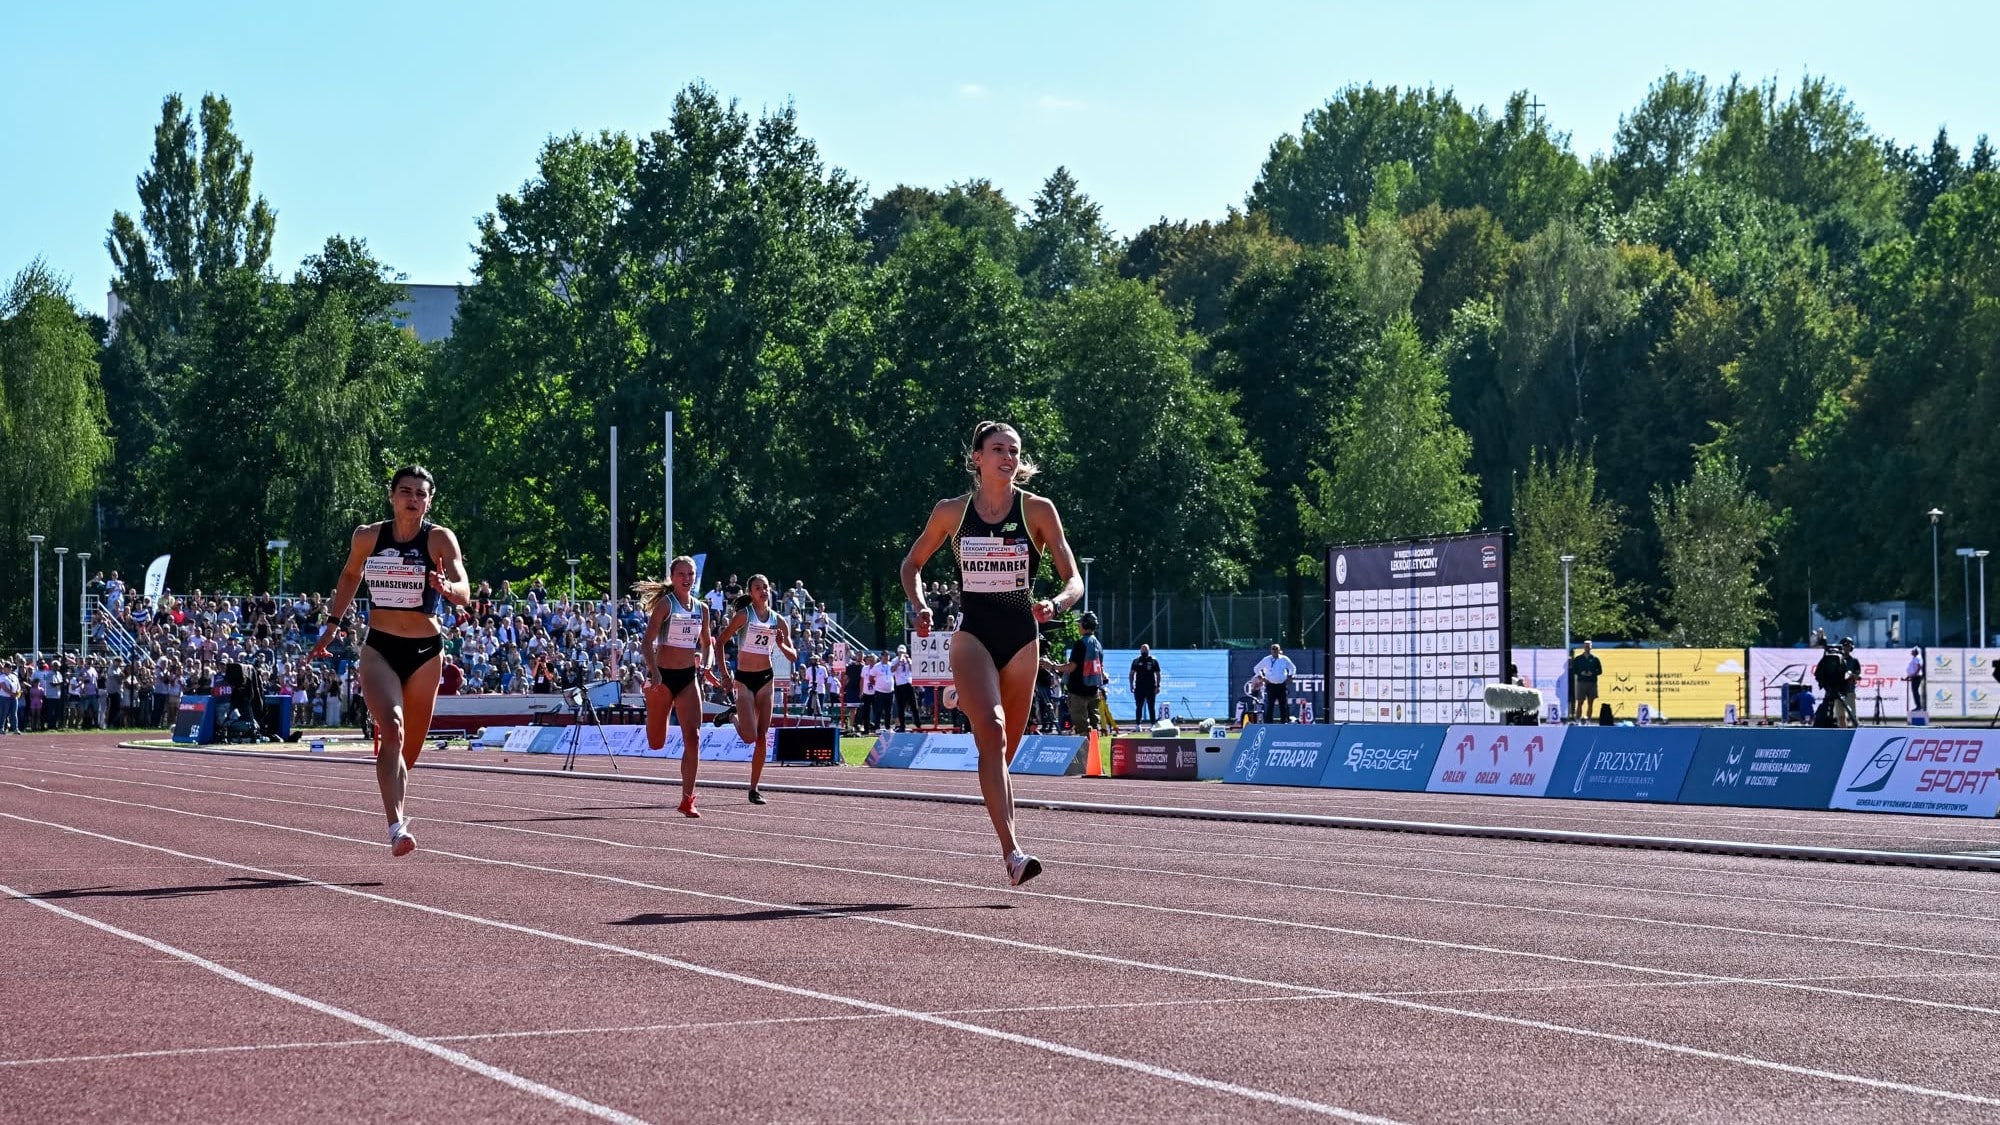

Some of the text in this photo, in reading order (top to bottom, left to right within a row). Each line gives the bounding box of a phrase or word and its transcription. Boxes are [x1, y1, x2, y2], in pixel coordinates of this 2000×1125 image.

[962, 559, 1027, 572] KACZMAREK
[682, 626, 690, 634] LIS
[754, 634, 769, 646] 23
[1292, 680, 1325, 692] TET
[1306, 707, 1312, 720] 6
[1551, 707, 1558, 720] 3
[1641, 707, 1649, 722] 2
[1265, 749, 1318, 768] TETRAPUR
[1363, 748, 1419, 760] ROUGH
[1594, 747, 1664, 771] PRZYSTAŃ
[1755, 748, 1791, 758] UNIWERSYTET
[1359, 758, 1412, 770] RADICAL
[1750, 760, 1811, 773] WARMIŃSKO-MAZURSKI
[1441, 770, 1536, 786] ORLEN ORLEN ORLEN
[1750, 775, 1778, 786] OLSZTYNIE
[1915, 769, 1997, 794] SPORT
